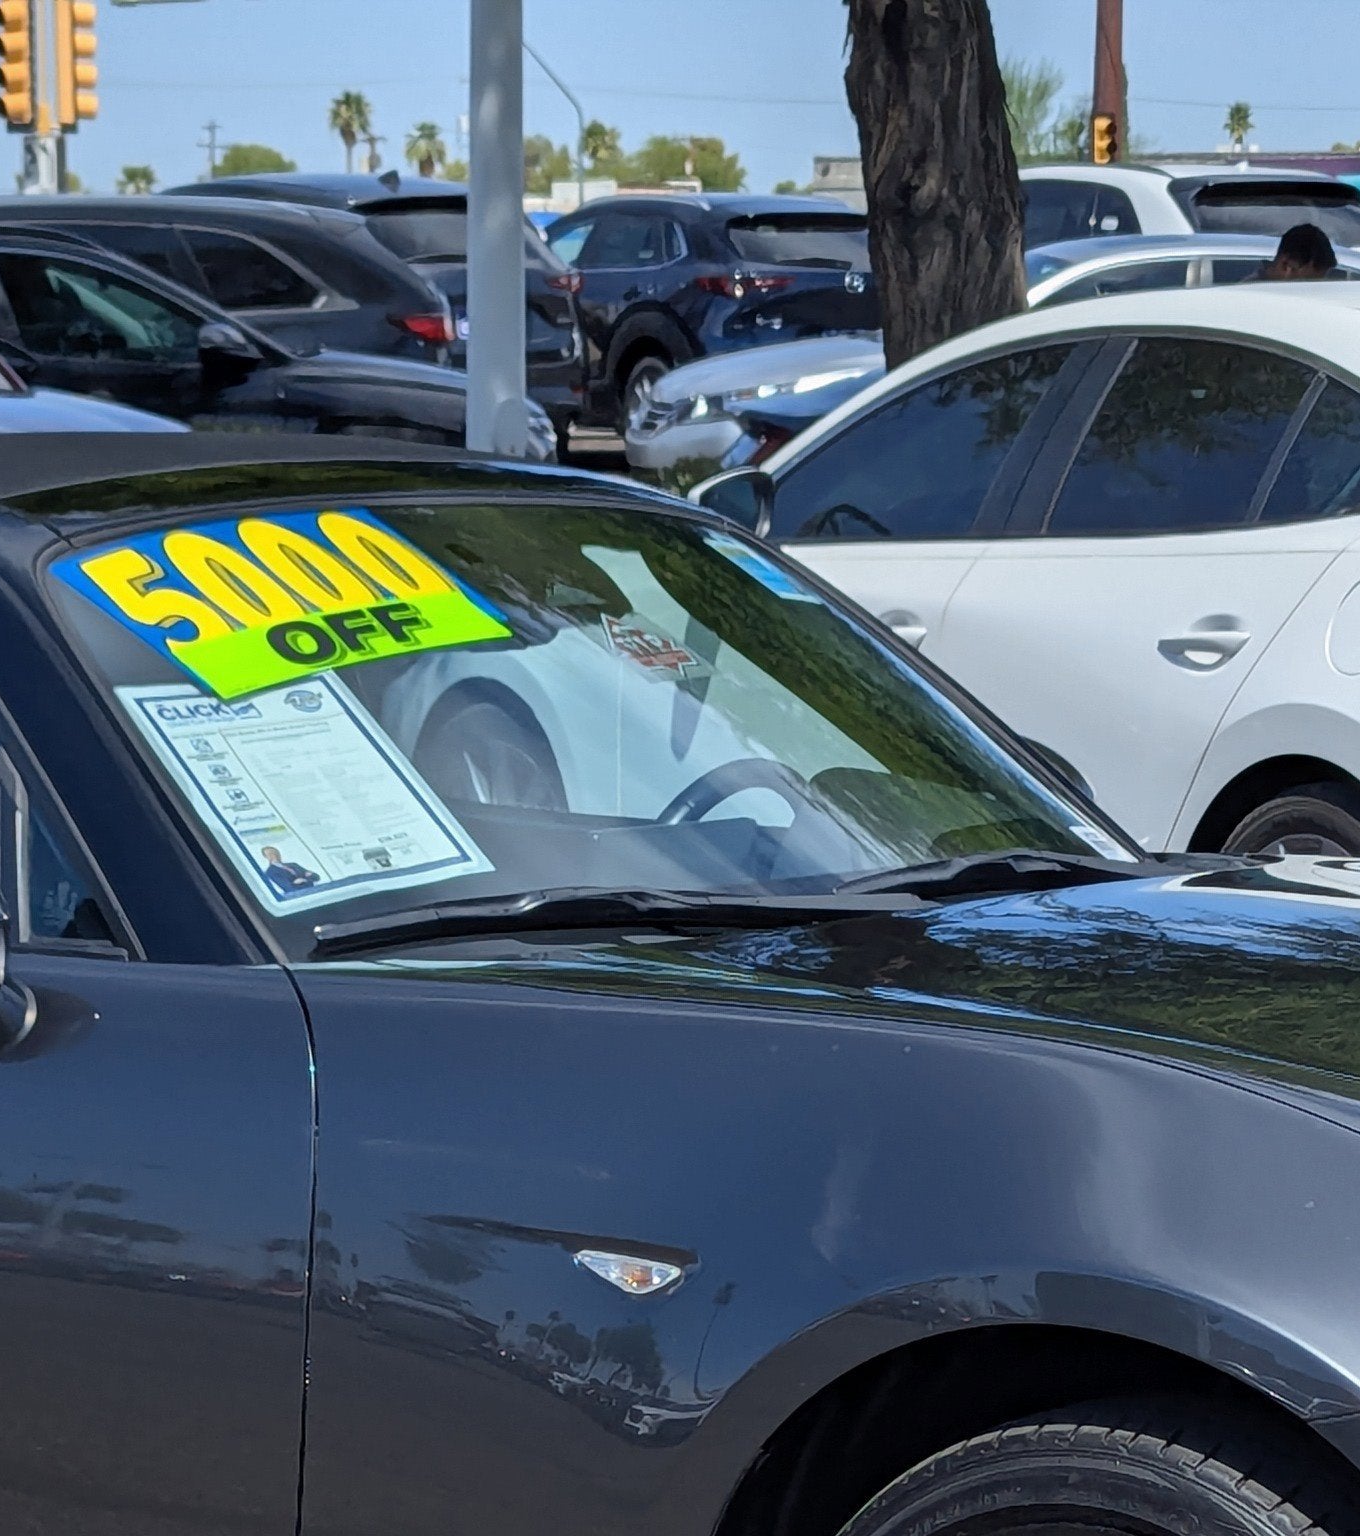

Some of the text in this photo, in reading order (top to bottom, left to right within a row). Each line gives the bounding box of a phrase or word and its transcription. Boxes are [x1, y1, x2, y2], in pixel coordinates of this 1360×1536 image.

[79, 510, 460, 650] 5000
[265, 602, 432, 668] OFF
[157, 702, 231, 721] CLICK
